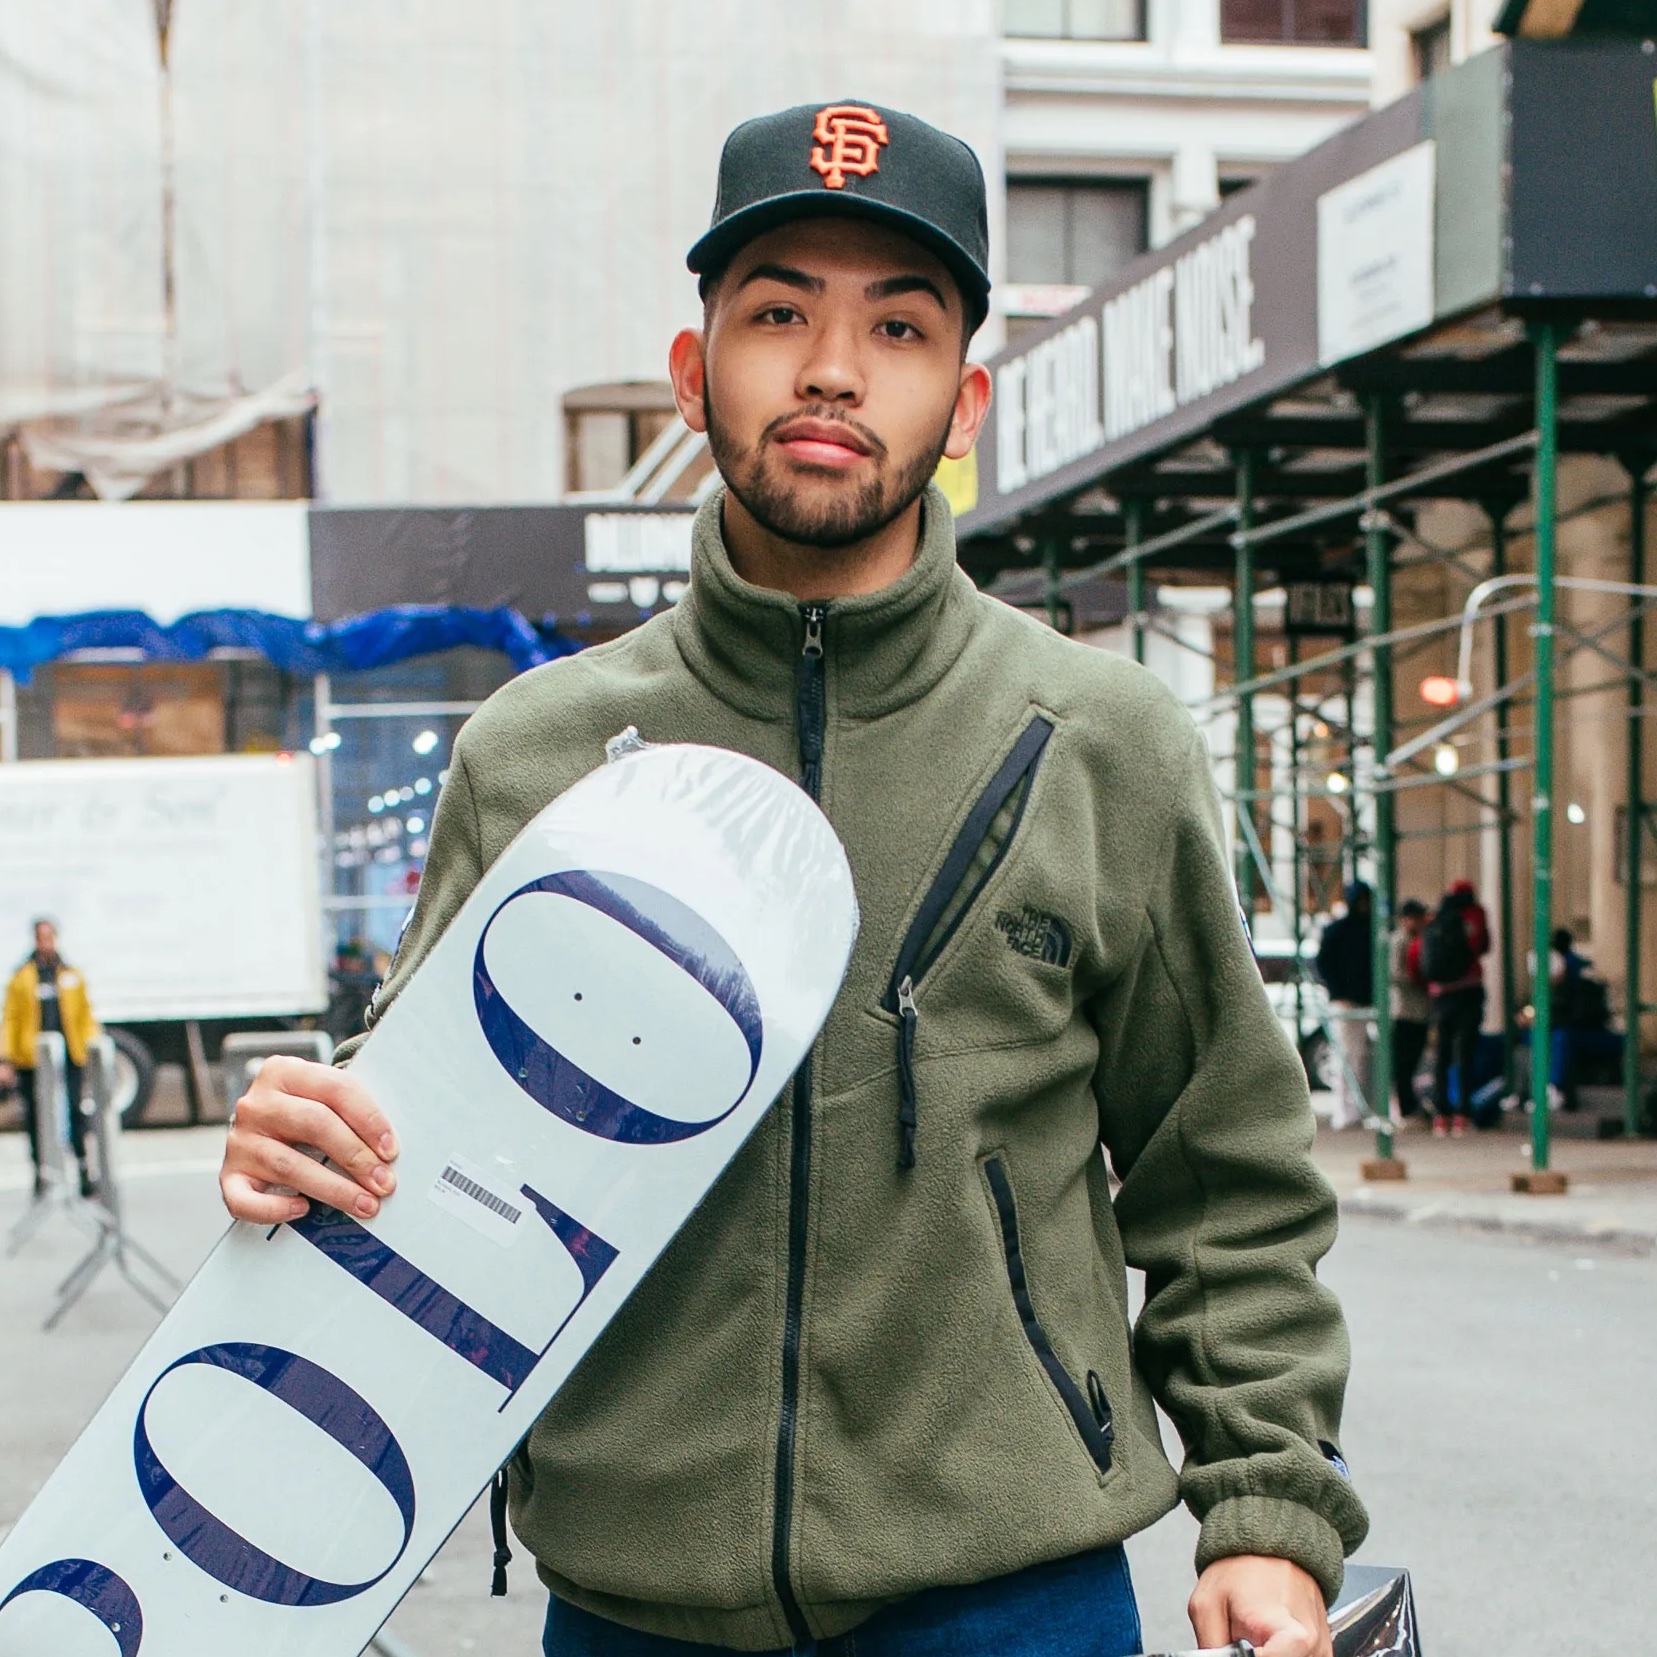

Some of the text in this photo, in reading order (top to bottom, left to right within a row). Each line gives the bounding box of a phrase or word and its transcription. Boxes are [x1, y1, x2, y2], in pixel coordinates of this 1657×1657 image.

[810, 105, 889, 189] SF
[995, 910, 1046, 946] NORTH
[1021, 902, 1049, 931] THE
[1006, 933, 1042, 959] FACE
[0, 870, 763, 1657] OLO
